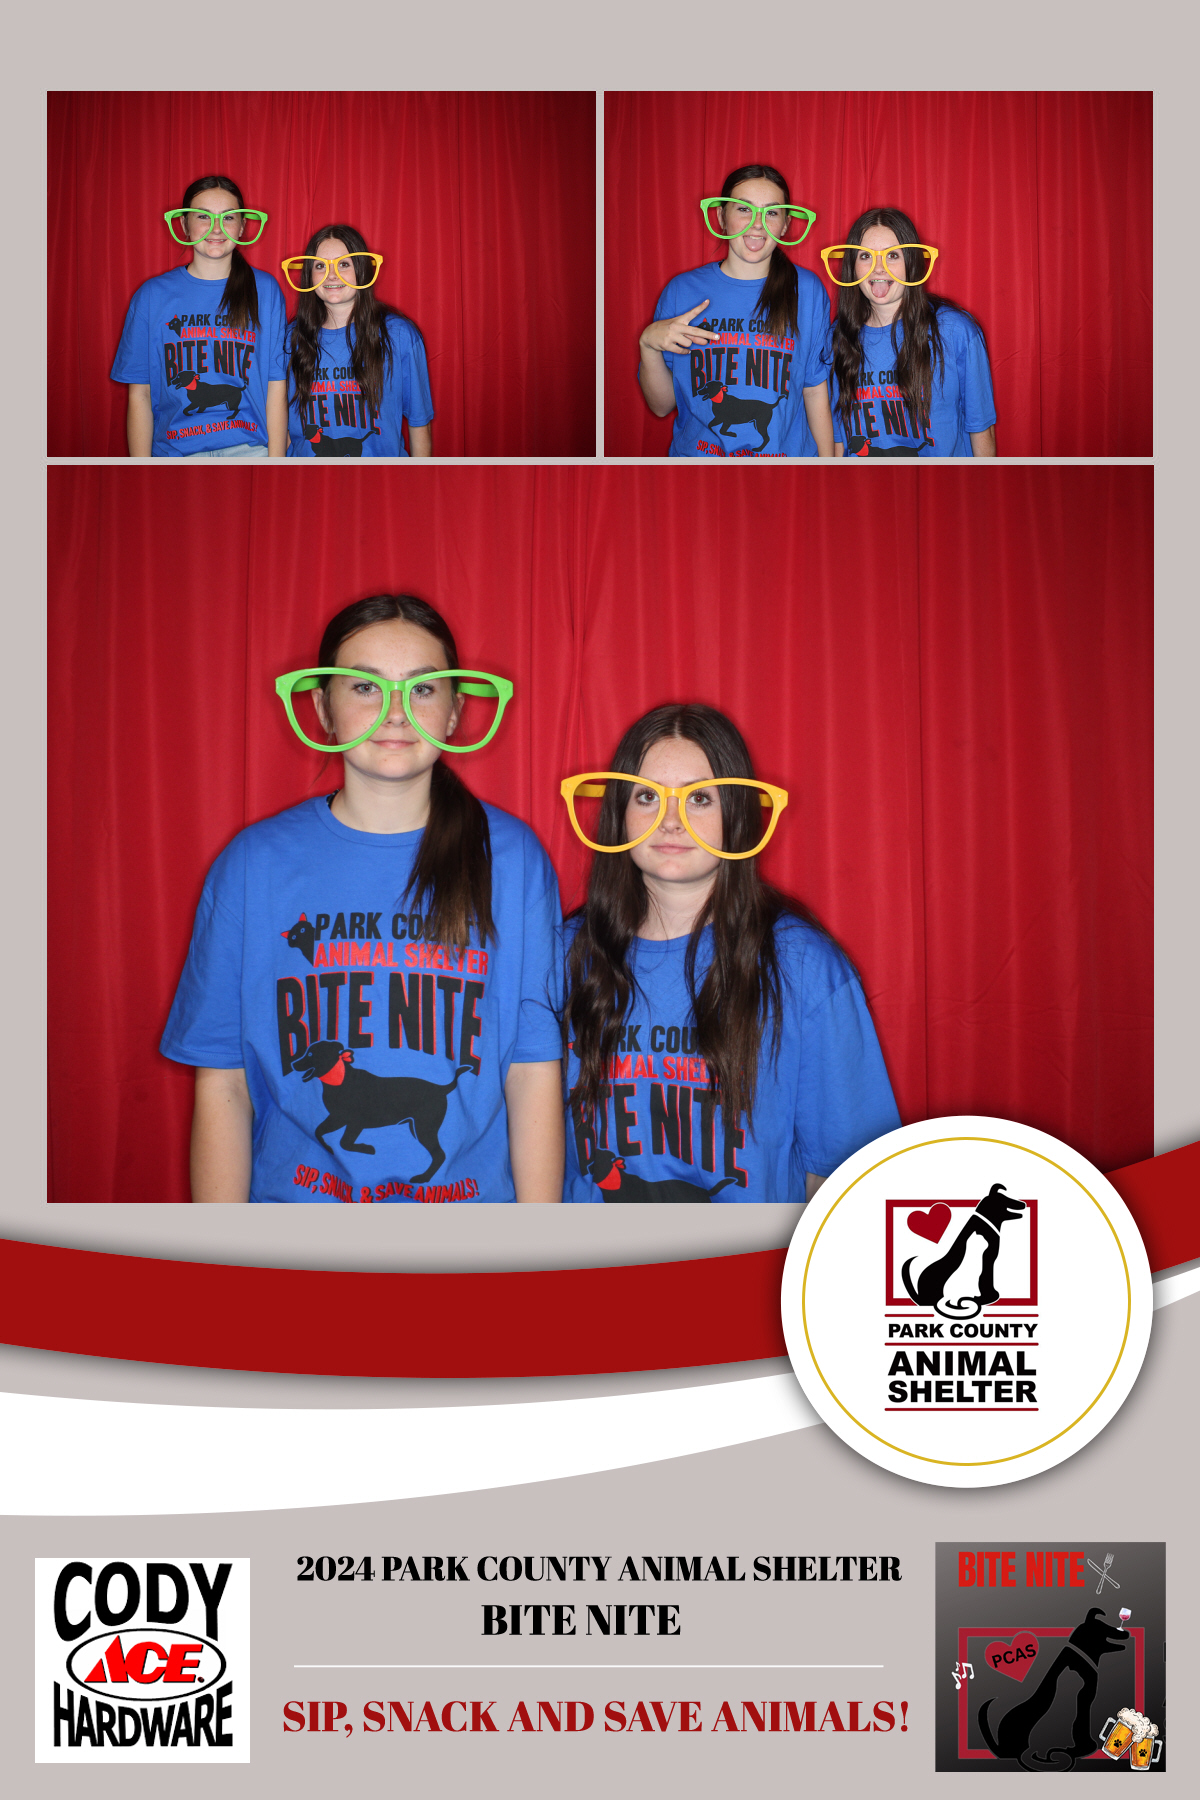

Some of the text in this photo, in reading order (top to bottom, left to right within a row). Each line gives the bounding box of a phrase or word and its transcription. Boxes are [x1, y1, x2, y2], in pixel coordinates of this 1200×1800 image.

[181, 314, 211, 327] PARK
[710, 318, 744, 332] PARK
[180, 327, 256, 343] ANIMAL SHELTER
[709, 332, 795, 351] ANIMAL SHELTER
[164, 340, 255, 387] BITE NITE
[314, 368, 329, 380] RK
[690, 347, 792, 400] BITE NITE
[166, 430, 180, 440] SIP,
[179, 425, 206, 438] SNACK,
[205, 424, 212, 433] &
[212, 420, 230, 432] SAVE
[696, 440, 709, 454] SIP,
[315, 912, 382, 941] PARK
[313, 942, 489, 976] ANIMAL SHELTER
[277, 971, 485, 1077] BITE NITE
[651, 1025, 704, 1055] COU
[663, 1056, 719, 1084] SHEL
[293, 1164, 319, 1194] SIP,
[360, 1186, 373, 1203] &
[375, 1182, 413, 1201] SAVE
[413, 1178, 480, 1203] ANIMALS!
